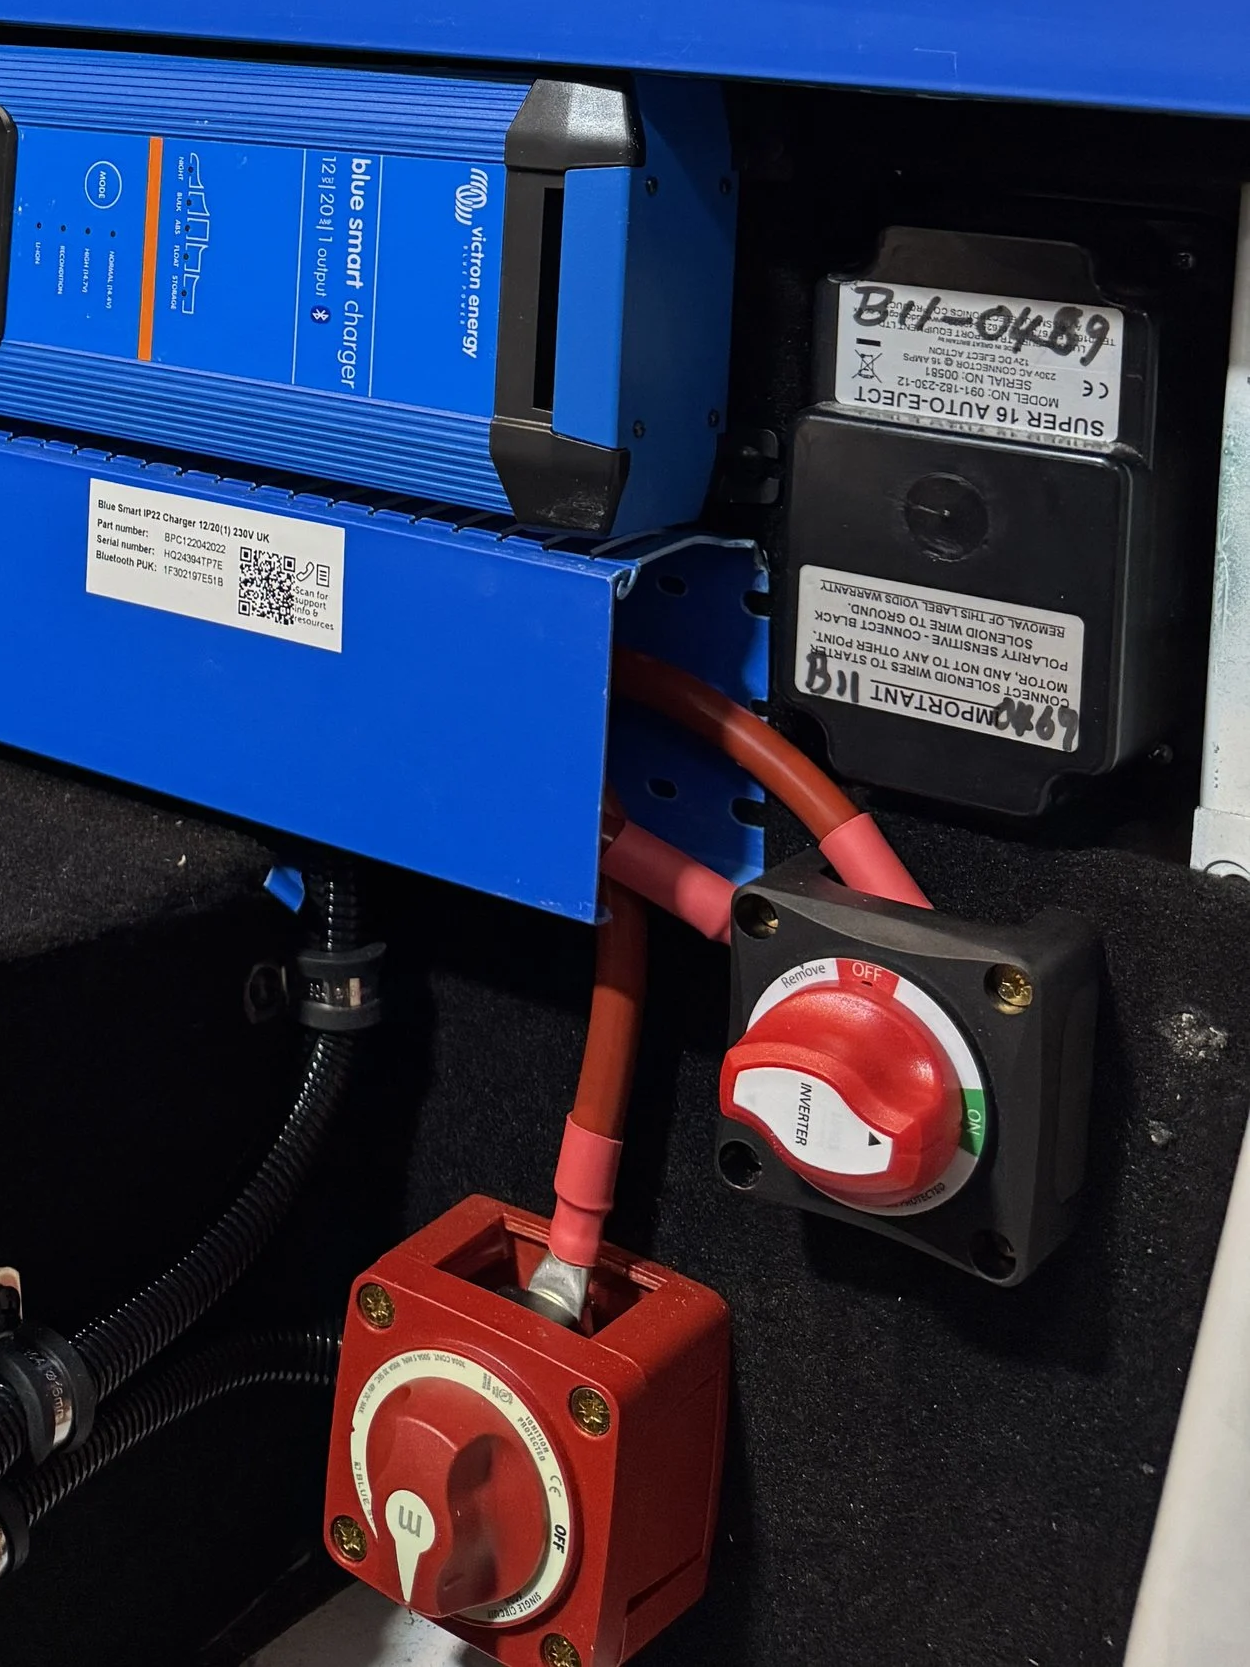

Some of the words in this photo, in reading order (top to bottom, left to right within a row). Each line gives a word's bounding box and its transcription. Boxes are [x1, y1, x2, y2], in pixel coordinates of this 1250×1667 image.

[322, 157, 337, 174] 12
[350, 157, 372, 211] blue
[320, 193, 335, 216] 20
[345, 217, 364, 290] smart
[469, 227, 487, 289] victron
[58, 245, 66, 295] RECONDITION
[107, 250, 115, 283] NORMAL
[314, 248, 329, 297] output
[170, 275, 178, 310] STORAGE
[462, 295, 480, 359] energy
[337, 300, 364, 389] charger
[929, 346, 965, 358] ACTION
[903, 352, 930, 364] AMPS
[965, 352, 996, 363] EJECT
[998, 356, 1013, 365] DC
[1013, 358, 1029, 367] 12v
[925, 366, 959, 381] 00581
[956, 361, 1017, 375] CONNECTOR
[962, 371, 984, 385] NO:
[1019, 368, 1034, 377] AC
[1034, 371, 1056, 381] 230v
[897, 375, 985, 398] 091-182-230-12
[987, 374, 1032, 391] SERIAL
[854, 386, 990, 420] AUTO-EJECT
[988, 388, 1010, 402] NO:
[1014, 392, 1059, 409] MODEL
[996, 406, 1019, 425] 16
[1027, 410, 1105, 437] SUPER
[98, 499, 116, 513] Blue
[117, 503, 142, 517] Smart
[143, 507, 161, 521] IP22
[163, 513, 196, 529] Charger
[199, 520, 231, 537] 12/20(1)
[233, 527, 254, 540] 230V
[256, 531, 270, 543] UK
[97, 518, 113, 531] Part
[115, 523, 149, 538] number:
[164, 533, 226, 554] BPC122042022
[96, 535, 120, 548] Serial
[121, 540, 155, 556] number:
[163, 549, 223, 570] HQ24394TP7E
[95, 550, 135, 567] Bluetooth
[136, 559, 157, 572] PUK:
[163, 565, 224, 587] 1F302197E51B
[295, 586, 315, 598] Scan
[316, 590, 329, 600] for
[820, 581, 882, 602] WARRANTY
[885, 594, 919, 609] VOIDS
[295, 596, 327, 610] support
[295, 606, 311, 616] info
[847, 602, 906, 624] GROUND.
[923, 602, 958, 617] LABEL
[295, 615, 334, 631] resources
[814, 610, 857, 628] BLACK
[909, 615, 926, 628] TO
[960, 609, 986, 623] THIS
[989, 616, 1005, 626] OF
[860, 621, 921, 641] CONNECT
[929, 619, 962, 635] WIRE
[1009, 619, 1066, 638] REMOVAL
[813, 630, 853, 648] POINT.
[856, 639, 899, 658] OTHER
[932, 634, 998, 657] SENSITIVE
[966, 627, 1033, 650] SOLENOID
[810, 644, 867, 665] STARTER
[870, 657, 888, 670] TO
[903, 650, 929, 664] ANY
[932, 656, 950, 669] TO
[1001, 649, 1068, 672] POLARITY
[891, 661, 932, 679] WIRES
[952, 660, 980, 675] NOT
[983, 667, 1012, 681] AND
[935, 674, 1001, 694] SOLENOID
[1015, 672, 1068, 694] MOTOR,
[870, 685, 998, 726] IMPORTANT
[1004, 685, 1070, 709] CONNECT
[780, 962, 826, 988] Remove
[852, 962, 883, 983] OFF
[795, 1081, 812, 1146] INVERTER
[966, 1108, 982, 1136] ON
[517, 1417, 546, 1462] PROTECTED
[525, 1416, 549, 1453] IGNITION
[356, 1473, 370, 1506] BLUE
[552, 1524, 567, 1554] OFF
[519, 1591, 542, 1613] SINGLE
[487, 1607, 517, 1619] CIRCUIT
